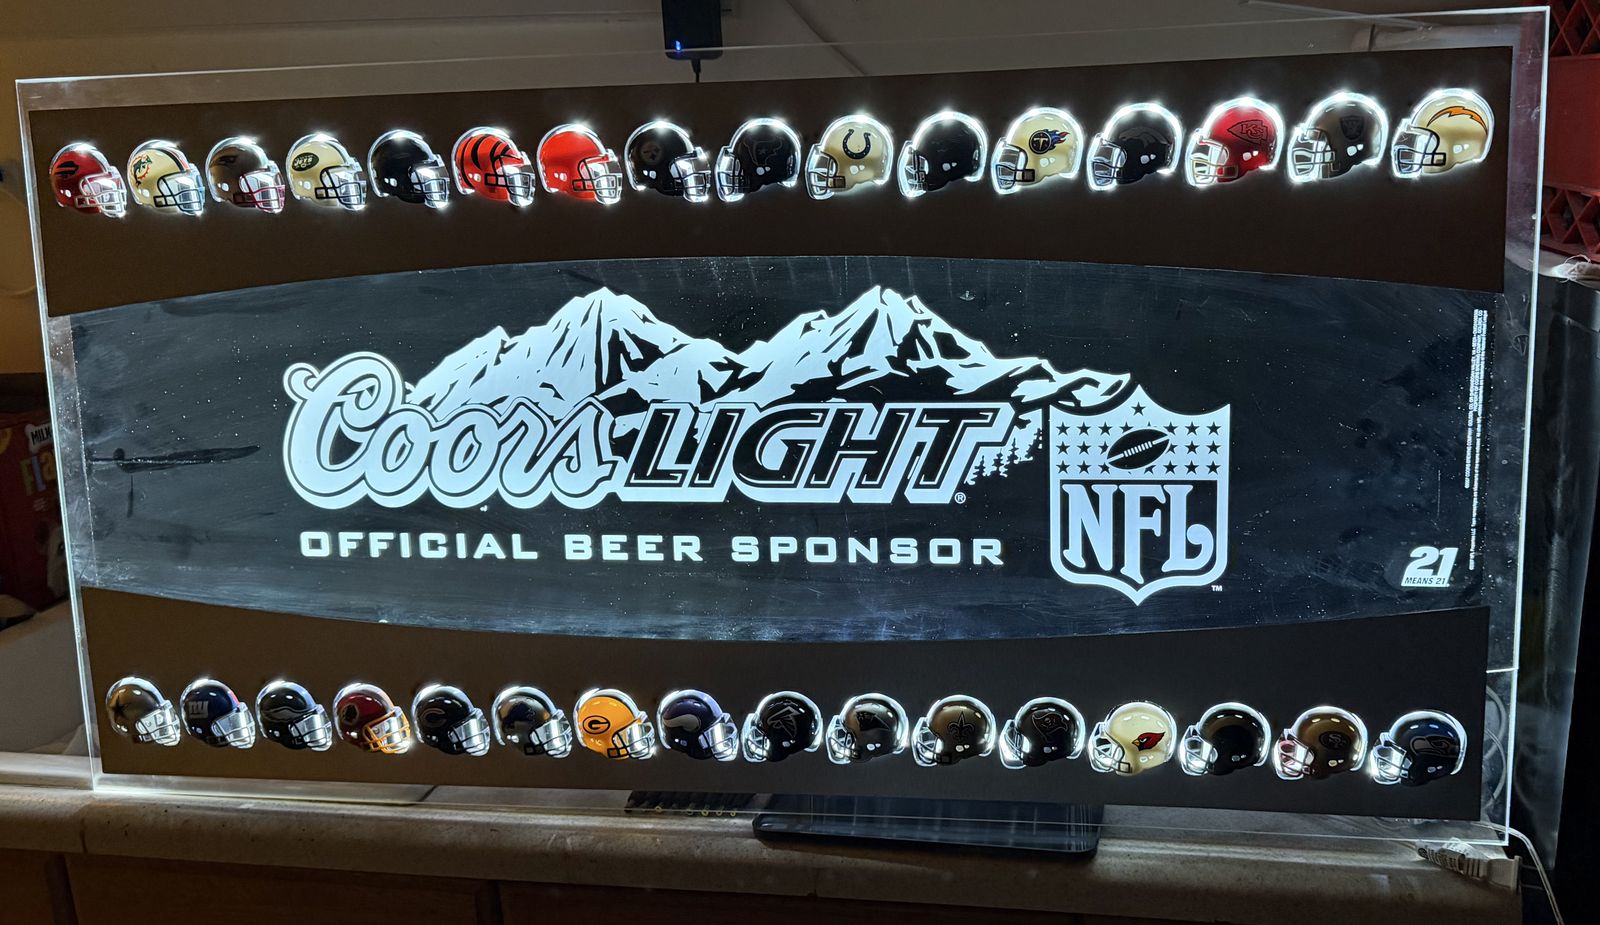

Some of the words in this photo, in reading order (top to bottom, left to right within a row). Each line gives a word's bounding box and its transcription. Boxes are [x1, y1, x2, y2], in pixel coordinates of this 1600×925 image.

[283, 351, 620, 508] Coors
[618, 401, 1013, 503] LIGHT
[300, 530, 538, 561] OFFICIAL
[563, 533, 703, 562] BEER
[731, 535, 1004, 566] SPONSOR
[1062, 484, 1214, 584] NFL
[1405, 546, 1458, 578] 21
[1404, 577, 1434, 585] MEANS
[1435, 577, 1446, 585] 21
[586, 718, 609, 732] G
